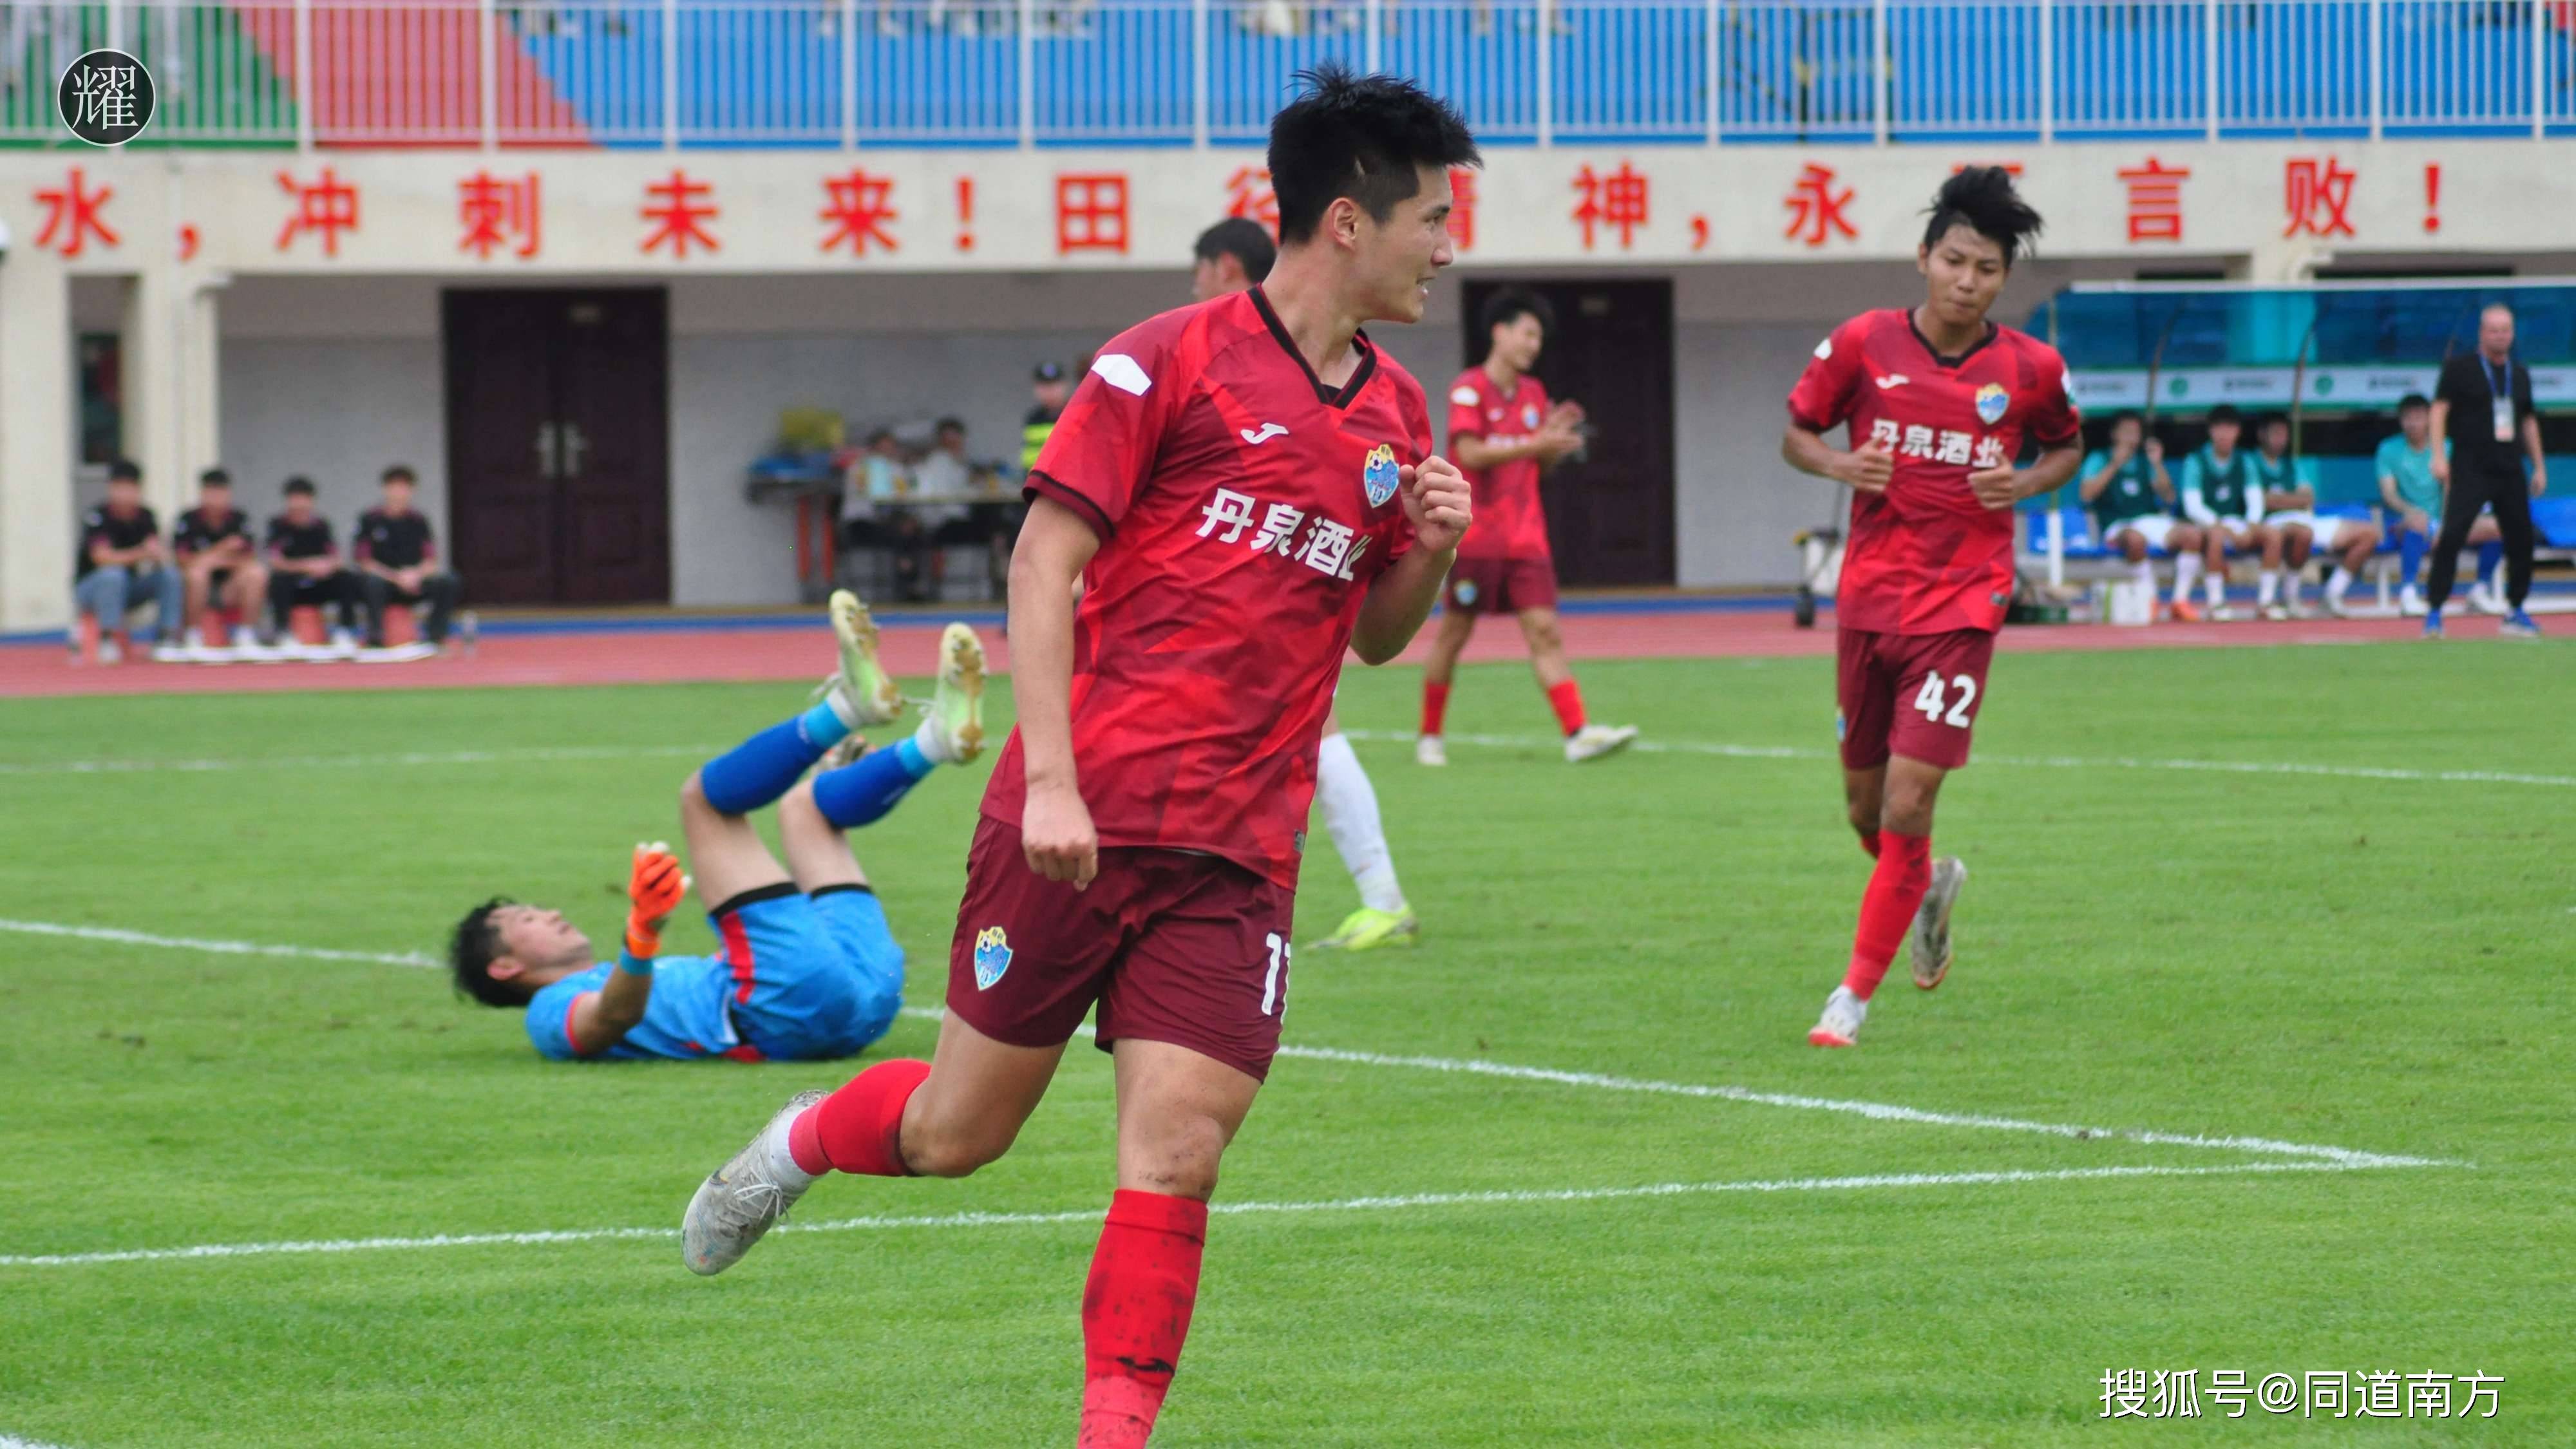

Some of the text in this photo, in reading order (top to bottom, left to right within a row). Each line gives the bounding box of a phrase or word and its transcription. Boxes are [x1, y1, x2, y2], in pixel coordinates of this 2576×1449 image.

[1870, 419, 2003, 468] 丹泉酒业
[1914, 670, 1976, 728] 42
[1261, 933, 1291, 1024] 1
